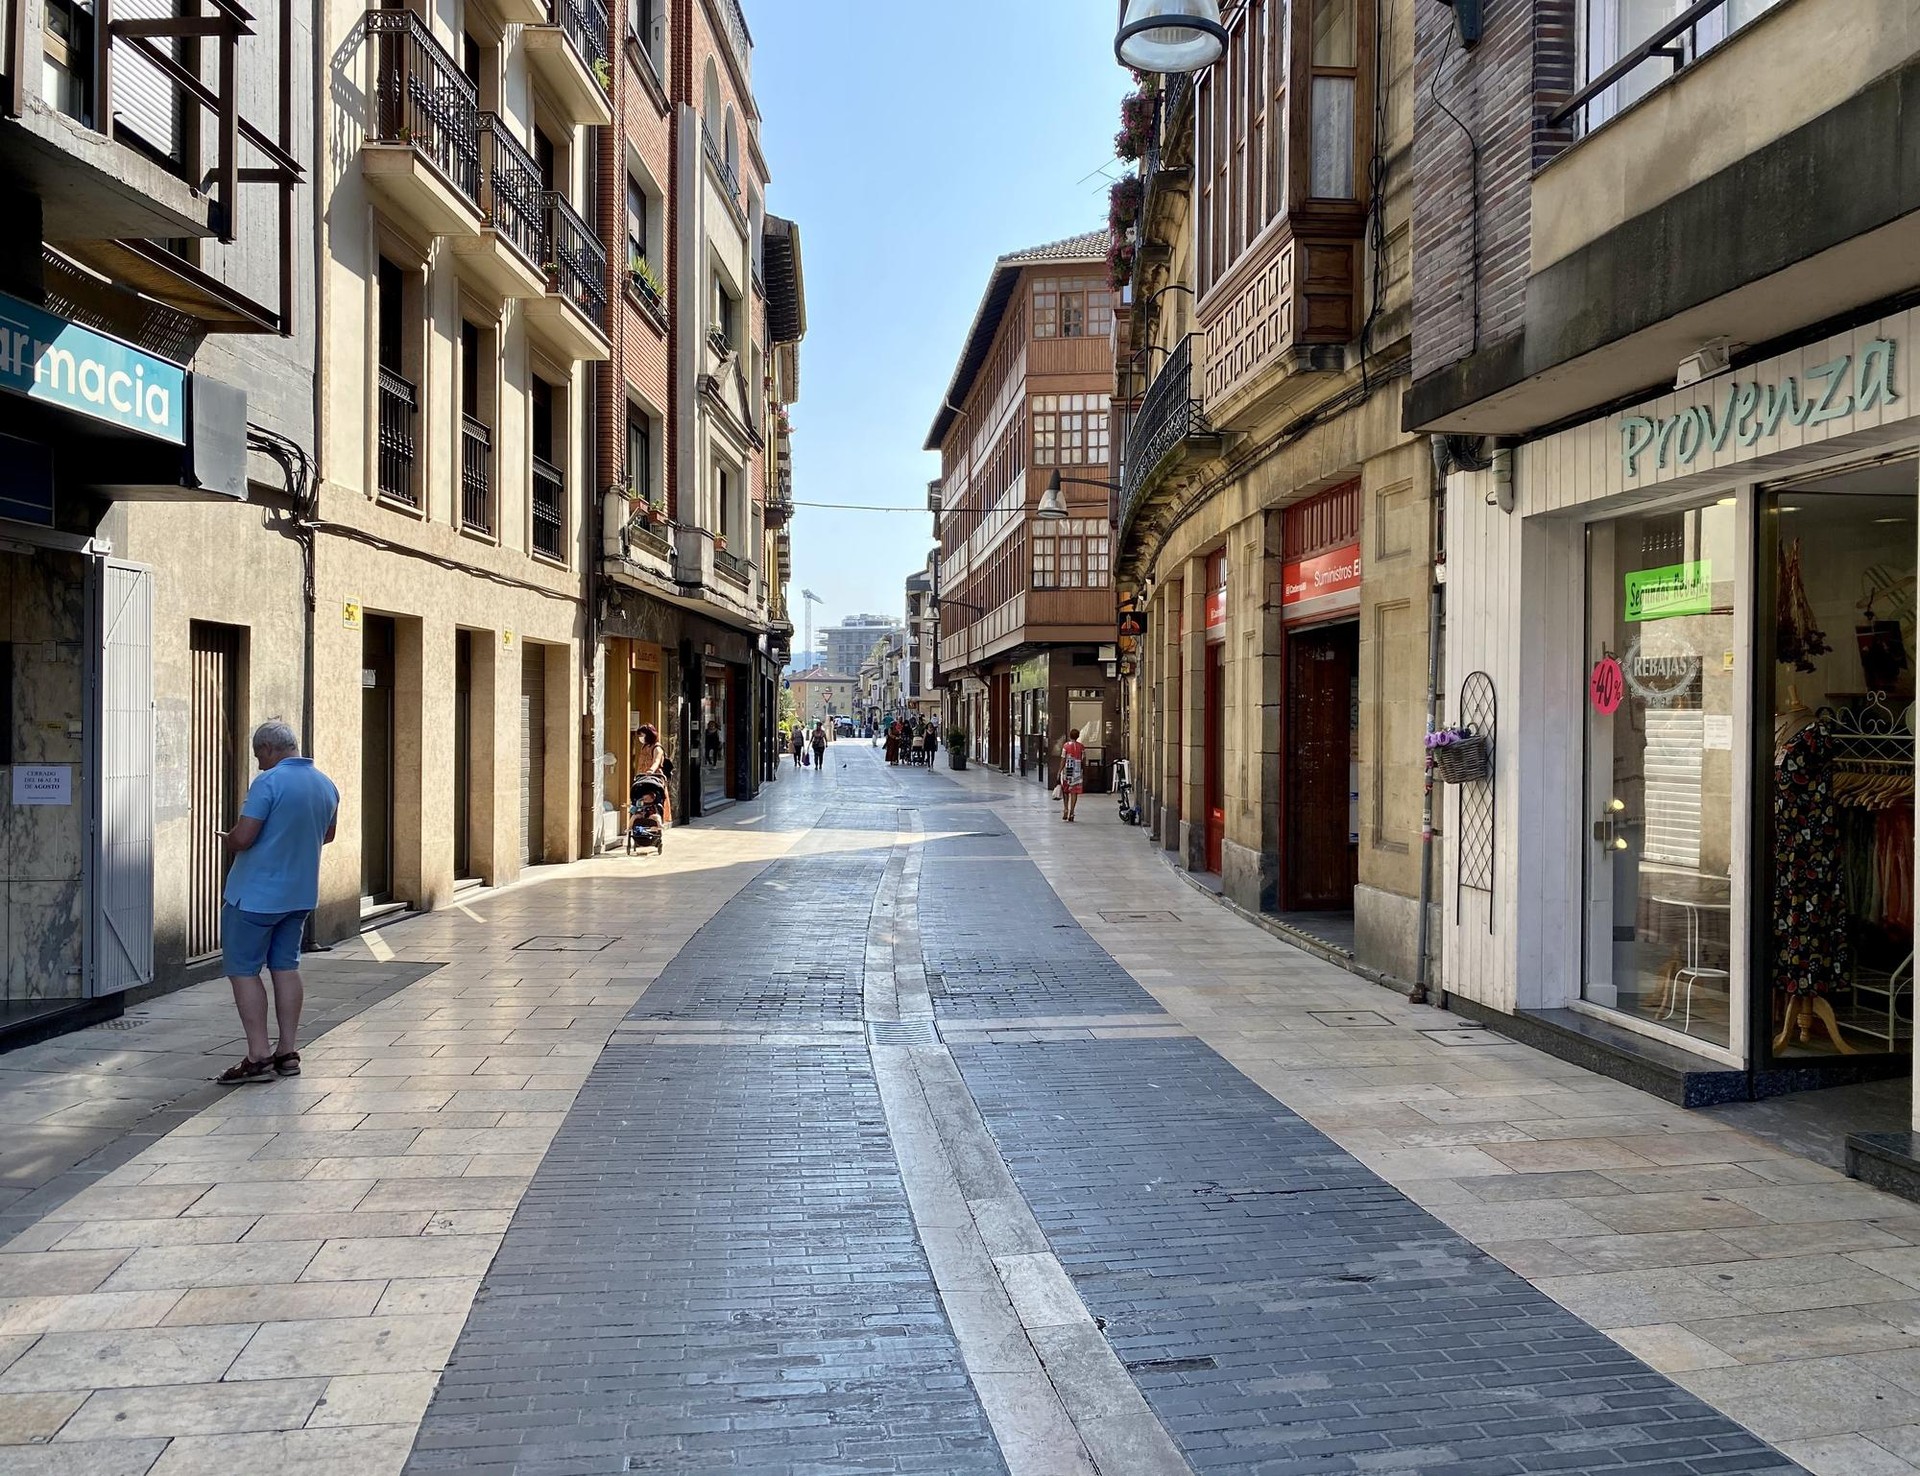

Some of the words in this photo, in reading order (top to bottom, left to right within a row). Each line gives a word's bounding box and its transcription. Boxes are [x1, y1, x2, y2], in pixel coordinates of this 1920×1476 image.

[1619, 336, 1899, 477] Provenza
[1314, 565, 1352, 587] Suministros
[1634, 656, 1687, 679] REBAJAS
